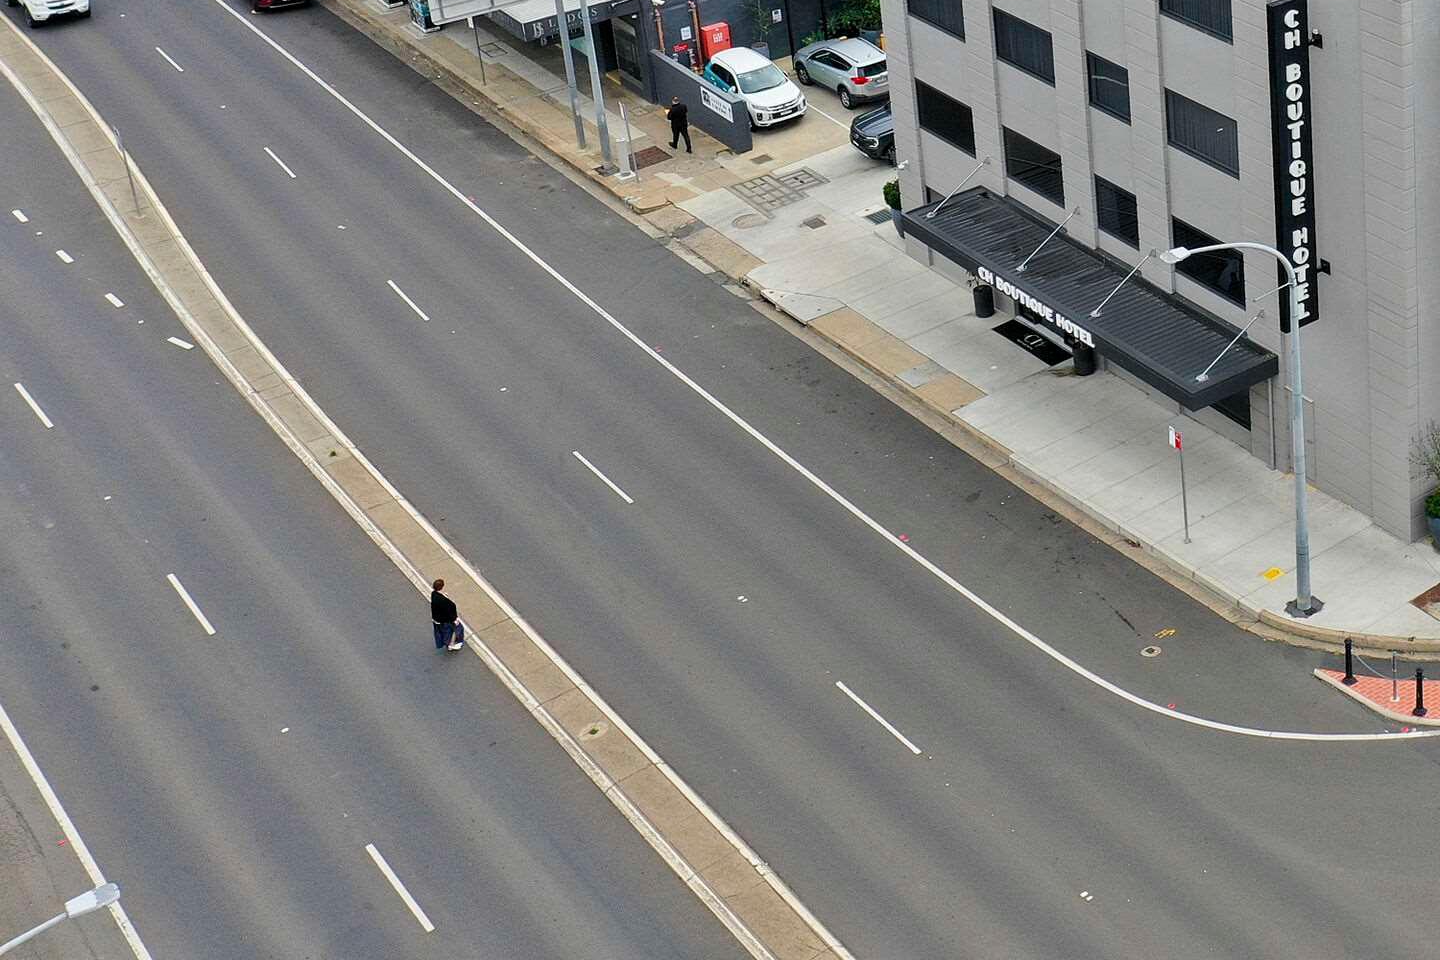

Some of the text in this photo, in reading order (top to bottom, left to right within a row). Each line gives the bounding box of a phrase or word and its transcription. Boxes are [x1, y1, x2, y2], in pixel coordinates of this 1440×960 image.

[1284, 9, 1310, 321] CH BOUTIQUE HOTEL
[977, 266, 1096, 349] CH BOUTIQUE HOTEL
